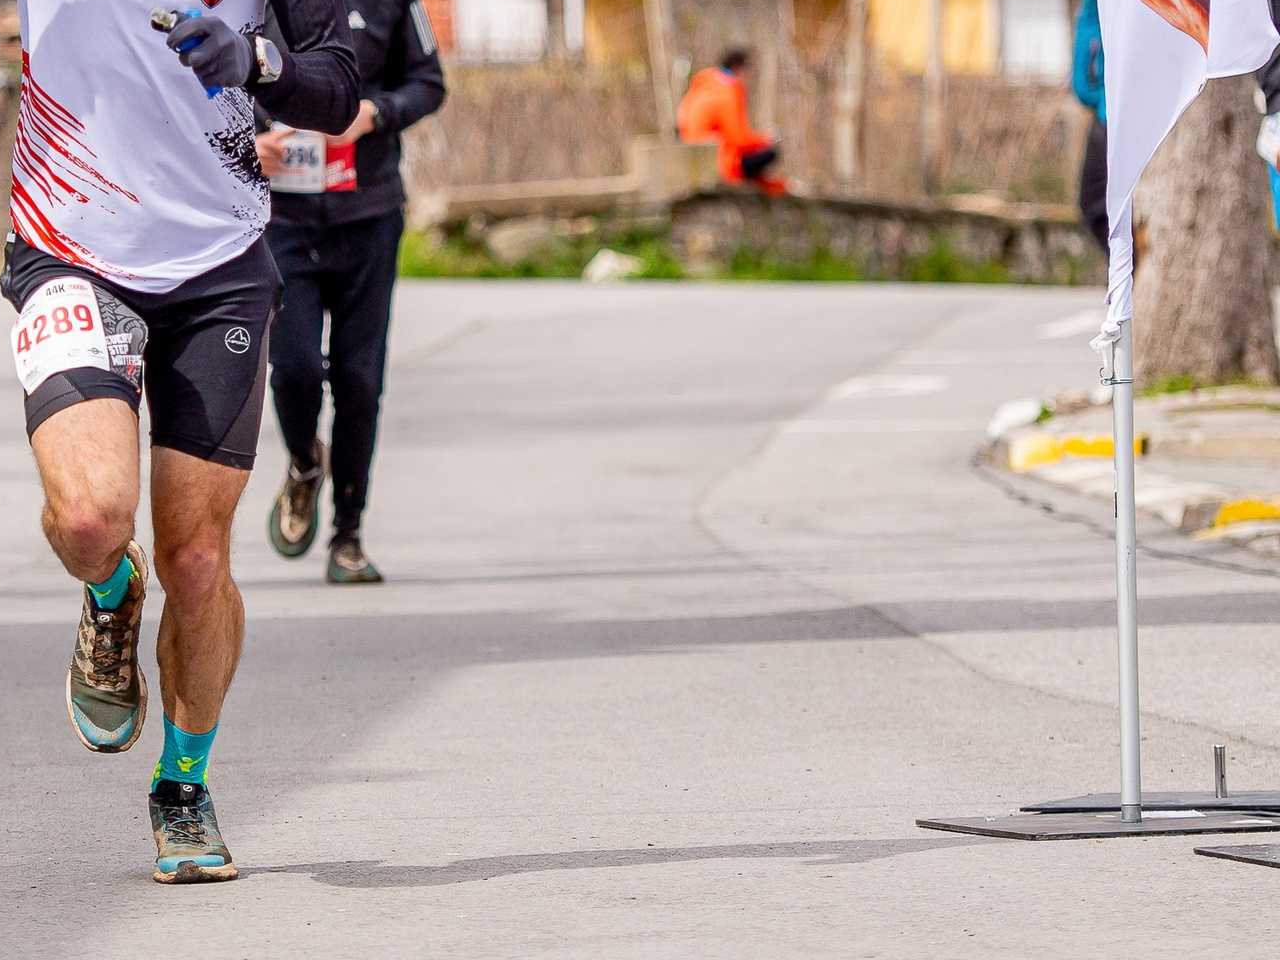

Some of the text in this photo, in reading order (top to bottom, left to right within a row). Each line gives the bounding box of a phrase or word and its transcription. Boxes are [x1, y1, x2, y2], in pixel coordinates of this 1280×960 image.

[45, 283, 66, 297] 44K
[16, 304, 95, 355] 4289
[108, 344, 130, 356] STEP
